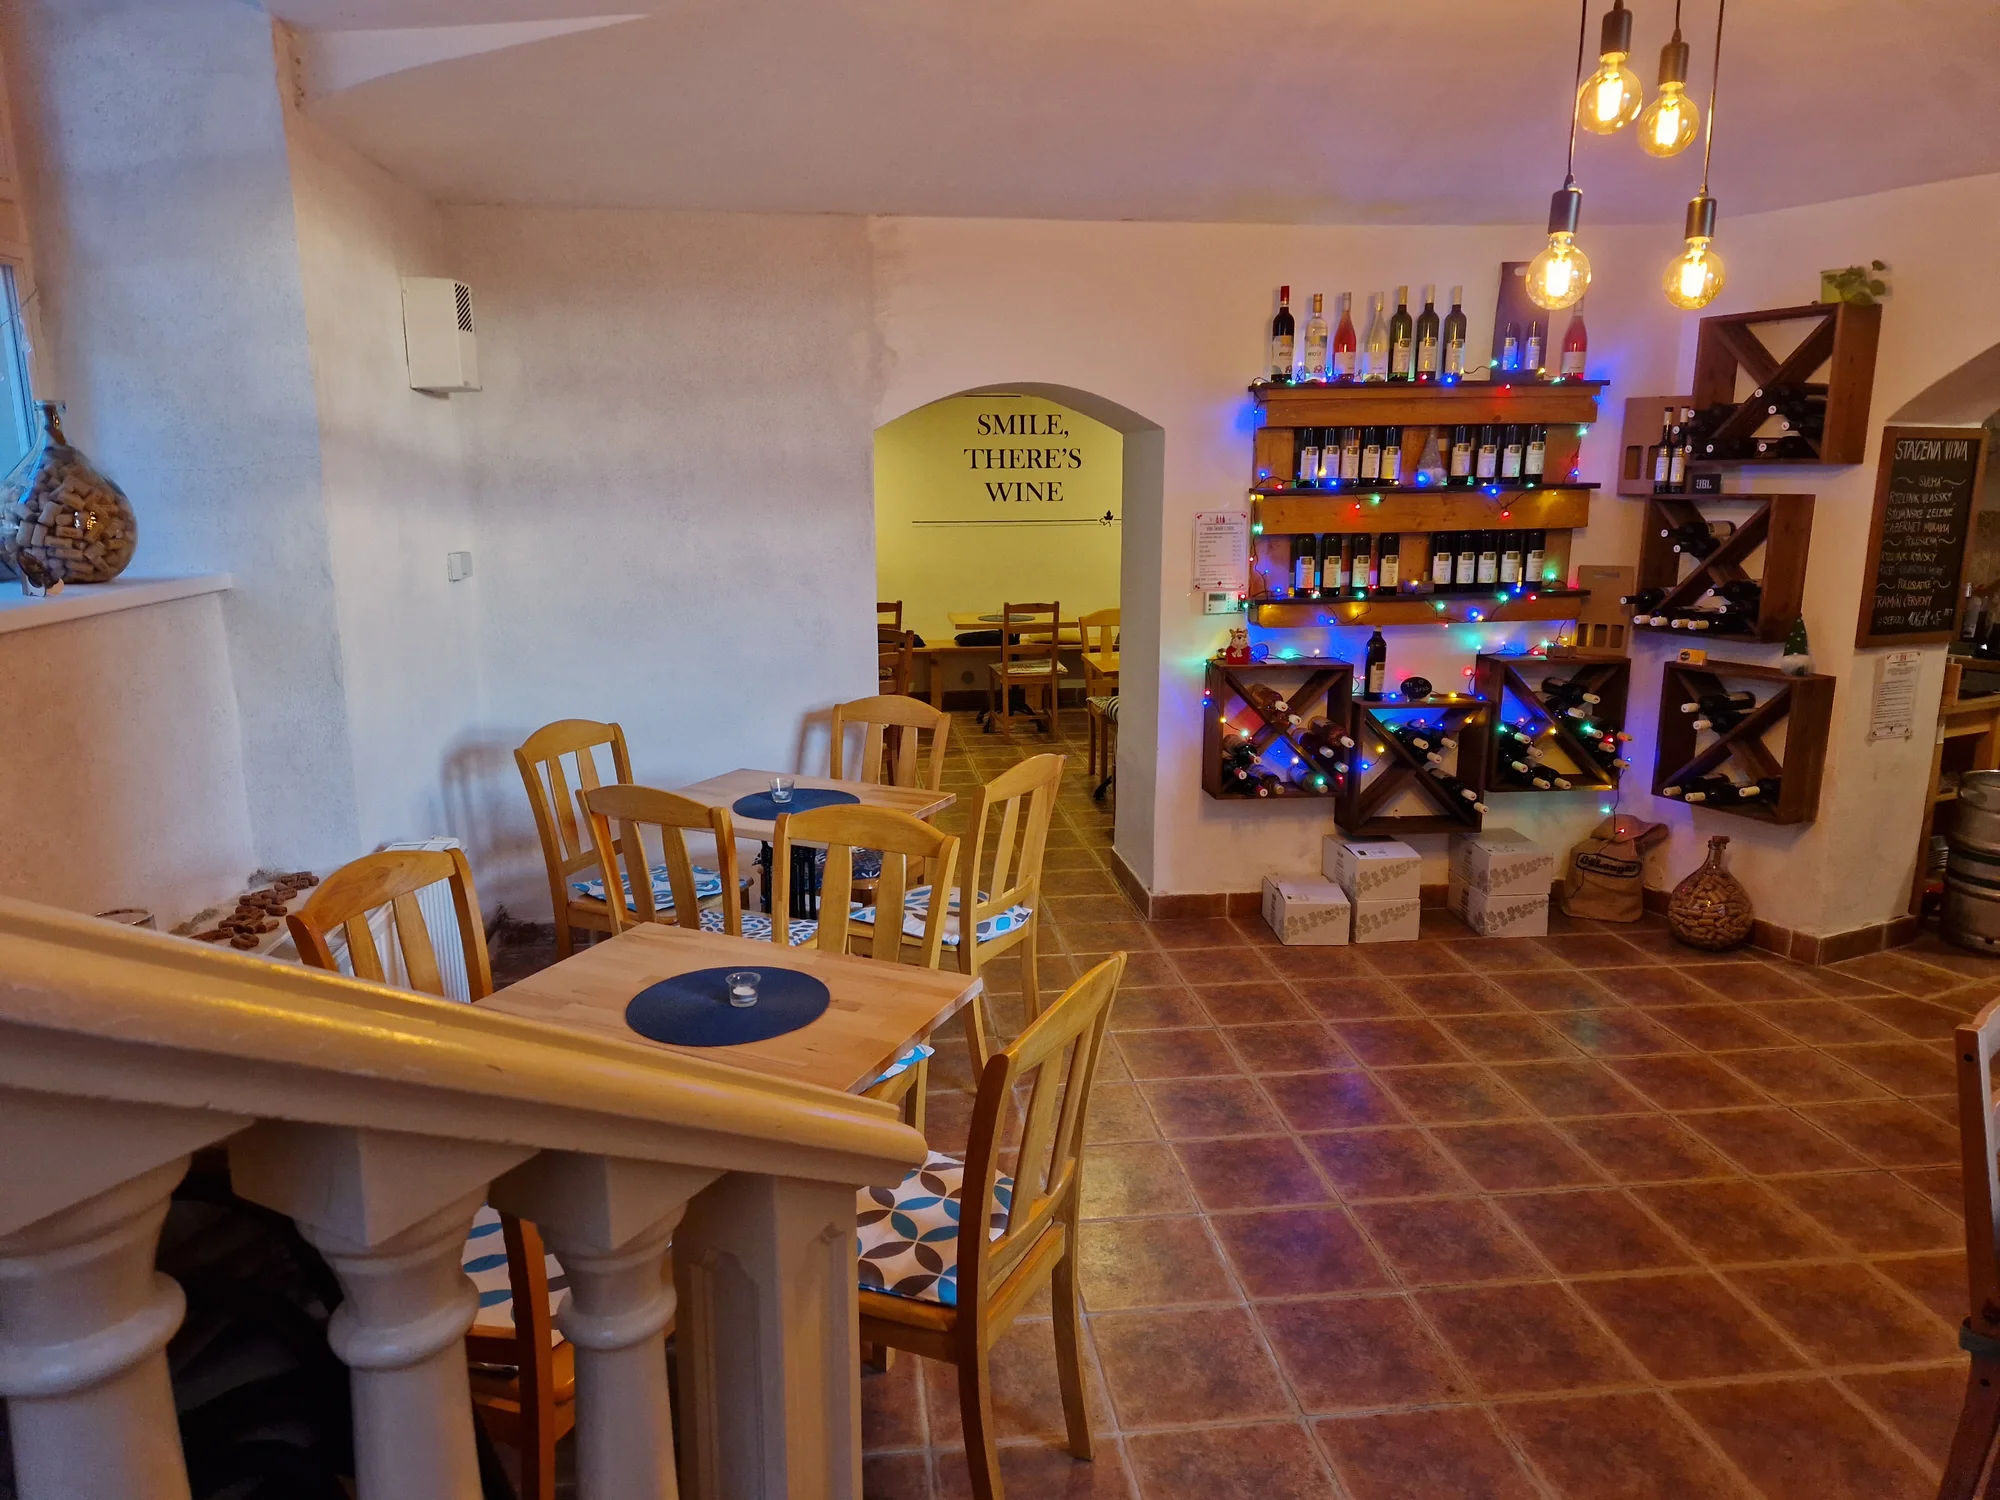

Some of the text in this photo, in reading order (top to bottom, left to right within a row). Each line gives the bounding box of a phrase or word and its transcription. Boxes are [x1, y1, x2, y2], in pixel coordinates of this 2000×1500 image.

[977, 413, 1069, 438] SMILE,
[963, 448, 1082, 469] THERE'S
[985, 481, 1064, 502] WINE
[1696, 479, 1712, 489] JBL
